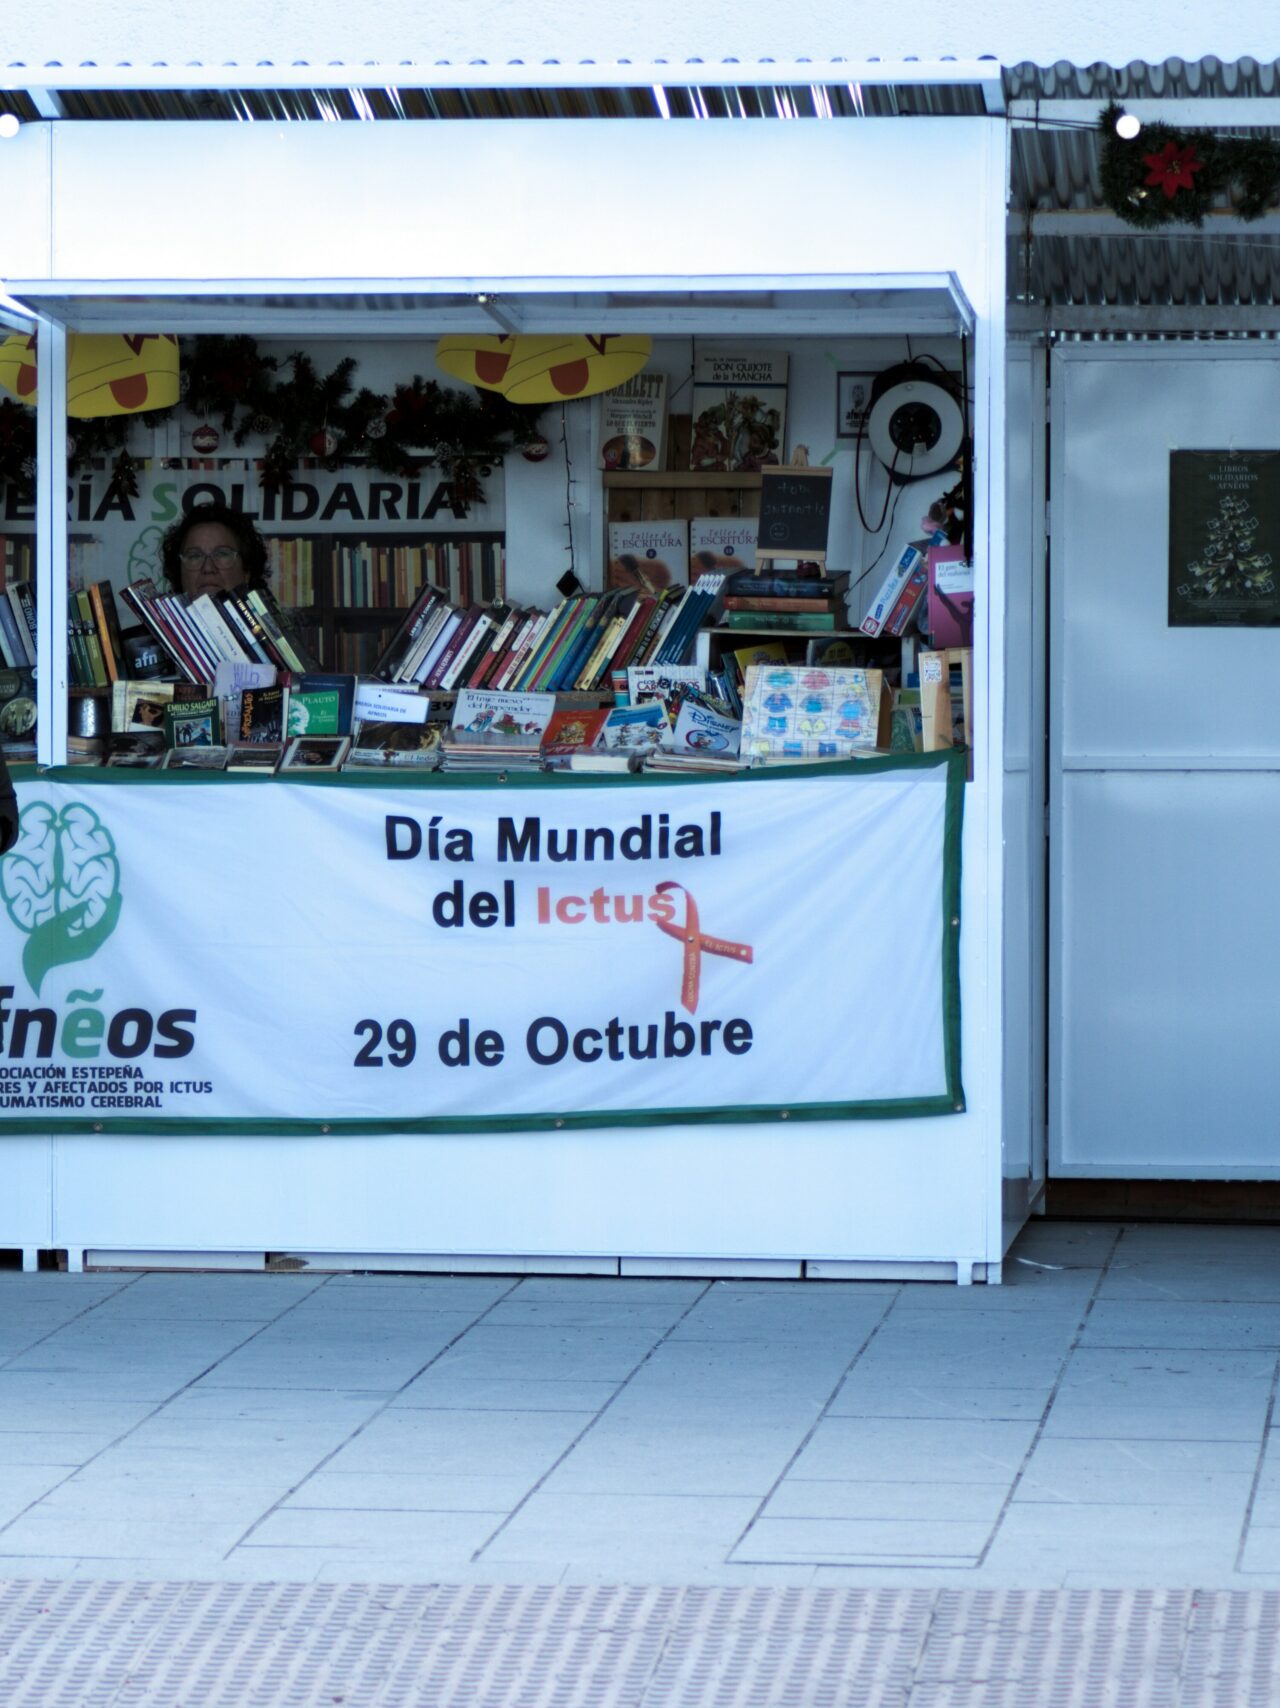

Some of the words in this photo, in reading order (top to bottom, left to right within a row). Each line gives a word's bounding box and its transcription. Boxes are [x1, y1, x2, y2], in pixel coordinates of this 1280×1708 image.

[713, 363, 733, 371] DON
[736, 363, 772, 372] QUIJOTE
[732, 373, 772, 381] MANCHA
[1208, 473, 1259, 481] SOLIDARIOS
[151, 482, 468, 521] SOLIDARIA
[622, 538, 683, 549] ESCRITURA
[167, 703, 190, 713] EMILIO
[190, 698, 218, 711] SALGARI
[302, 695, 336, 705] PLAUTO
[385, 813, 475, 862] Día
[496, 811, 722, 862] Mundial
[432, 879, 516, 928] del
[537, 885, 677, 925] Ictus
[353, 1018, 417, 1068] 29
[438, 1017, 505, 1067] de
[526, 1011, 754, 1066] Octubre
[72, 1064, 144, 1080] ESTEPEÑA
[28, 1082, 37, 1094] Y
[43, 1081, 128, 1094] AFECTADOS
[134, 1081, 164, 1094] POR
[169, 1080, 213, 1094] ICTUS
[91, 1095, 163, 1108] CEREBRAL
